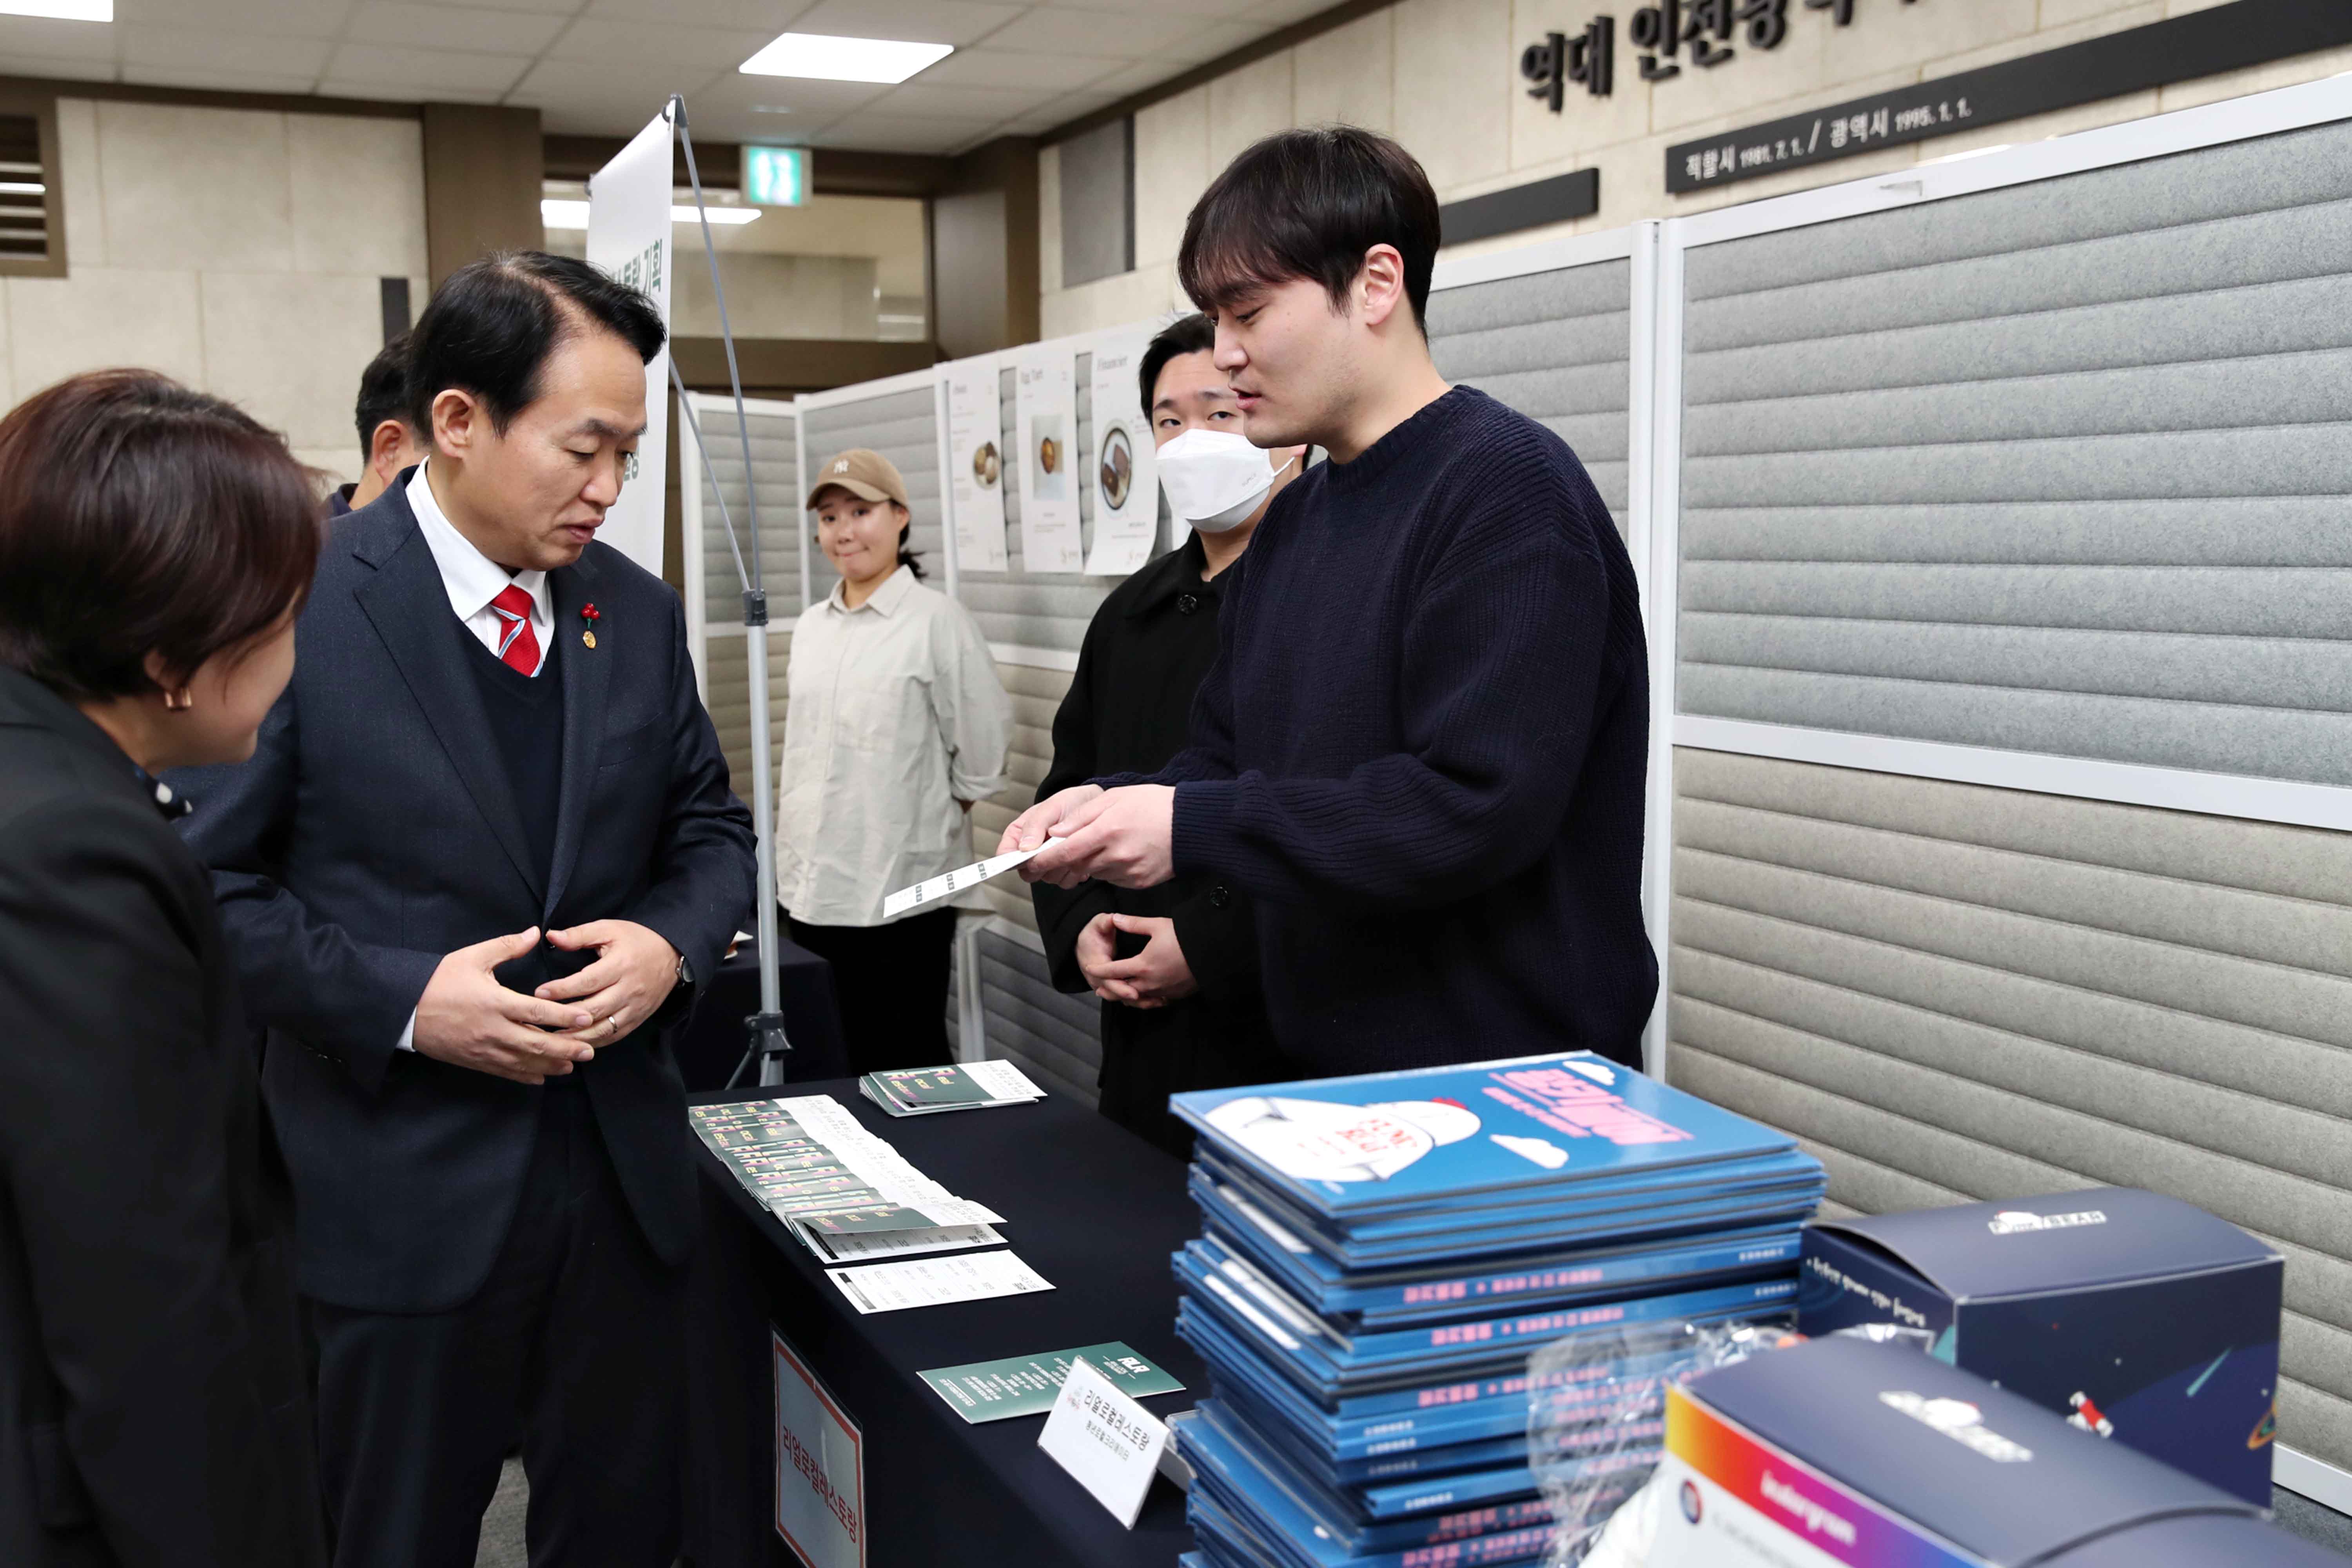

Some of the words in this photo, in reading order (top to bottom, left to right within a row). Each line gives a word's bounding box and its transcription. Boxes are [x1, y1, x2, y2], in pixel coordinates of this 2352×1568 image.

[1521, 15, 1615, 114] 역대
[1686, 144, 1735, 181] 직할시
[1830, 106, 1888, 148] 광역시
[1117, 1356, 1150, 1373] RLR
[1083, 1389, 1151, 1452] 리얼로컬레스토랑
[783, 1425, 857, 1544] 리얼로컬레스토랑
